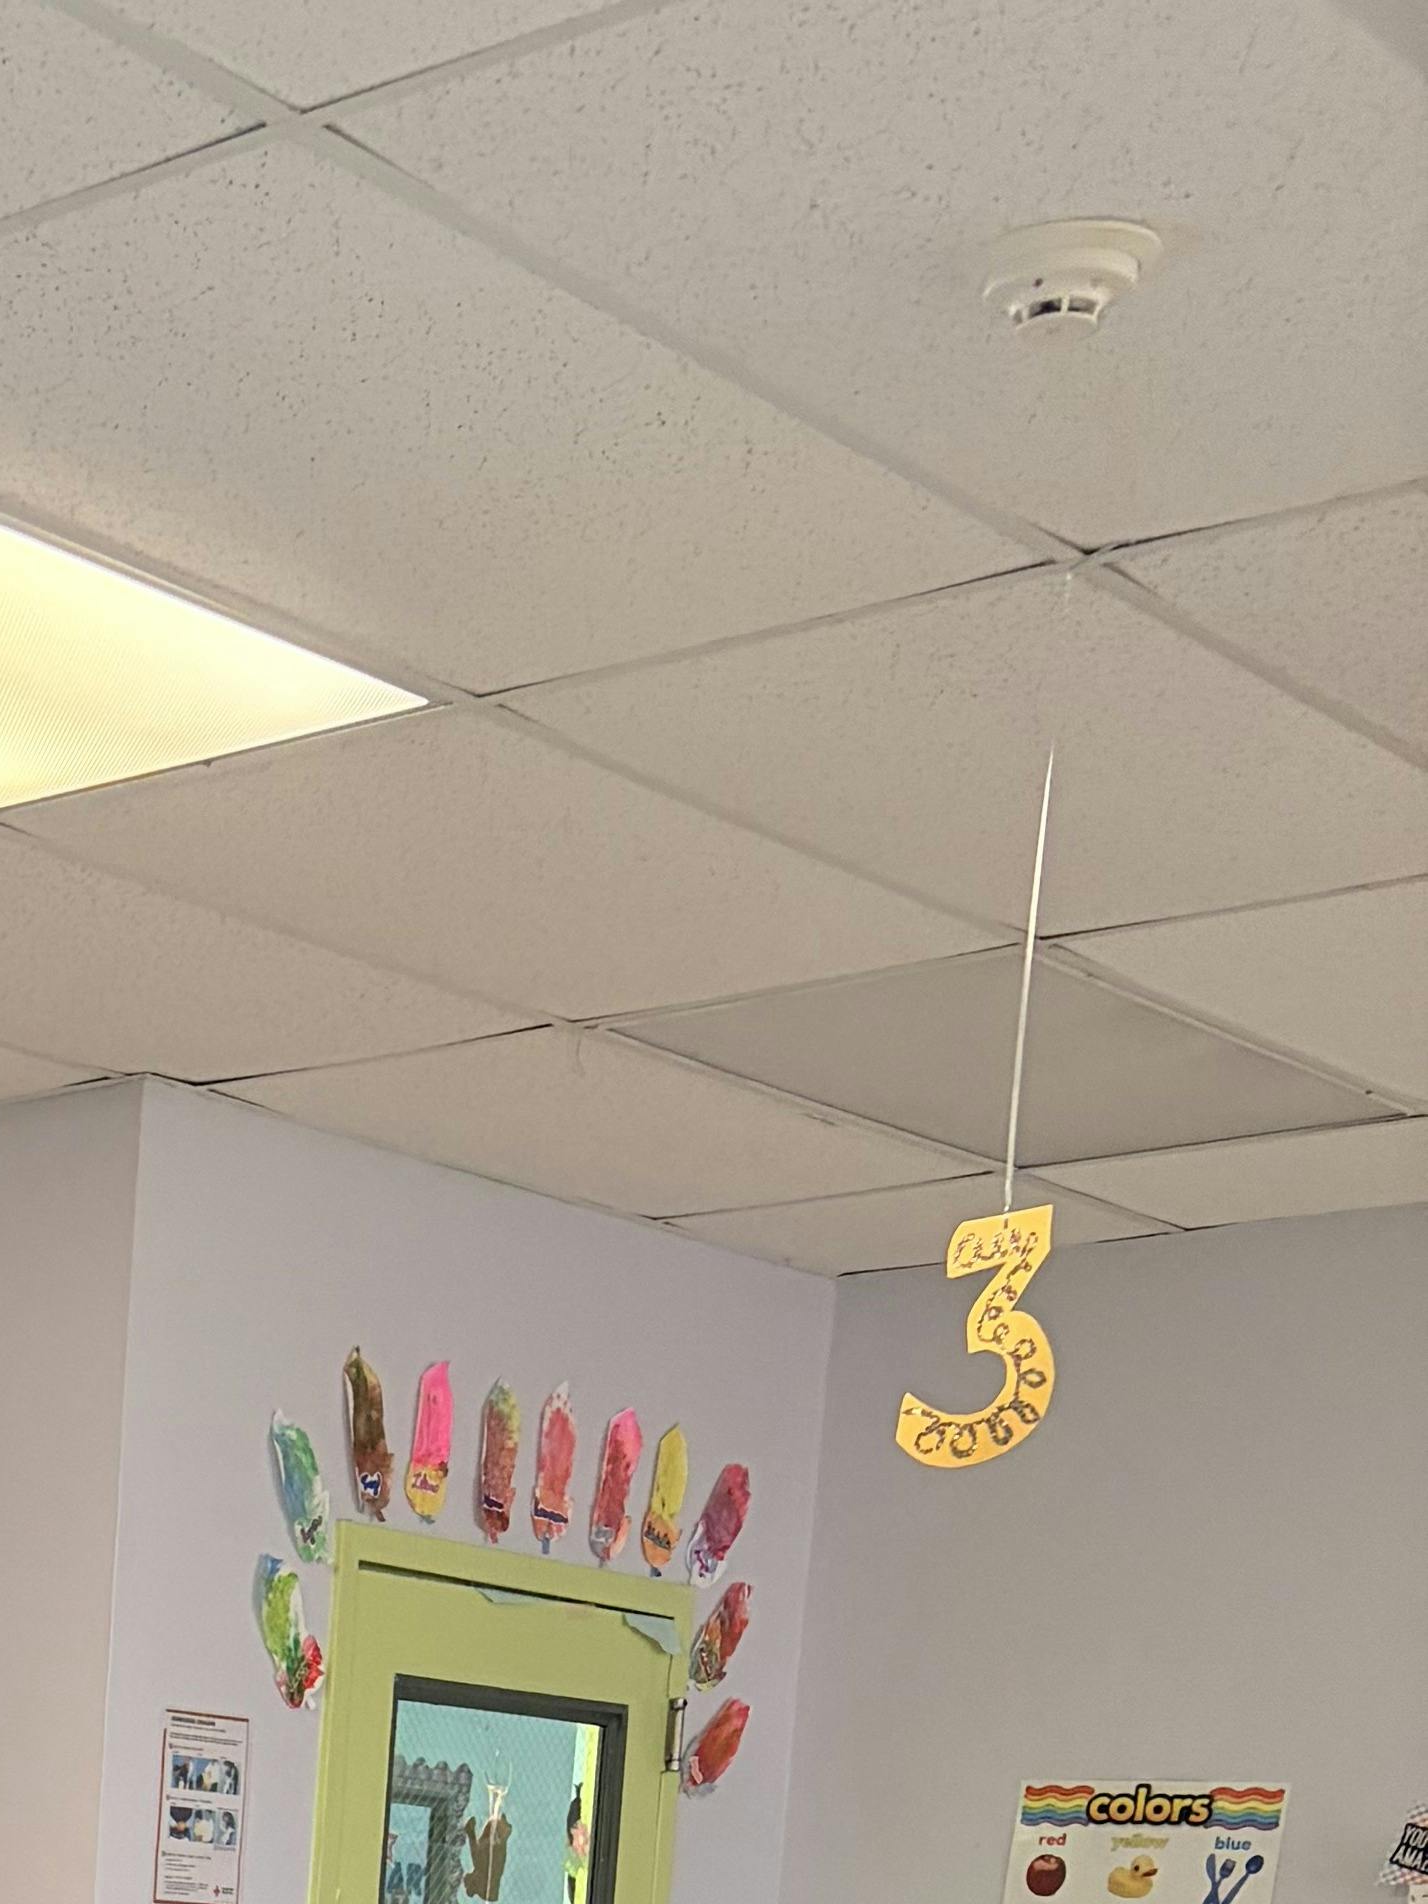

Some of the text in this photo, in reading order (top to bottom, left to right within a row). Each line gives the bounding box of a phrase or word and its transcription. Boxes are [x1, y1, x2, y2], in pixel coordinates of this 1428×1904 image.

[896, 1202, 1056, 1470] 3
[1086, 1783, 1215, 1827] colors
[1038, 1833, 1067, 1848] red
[1214, 1836, 1252, 1852] blue
